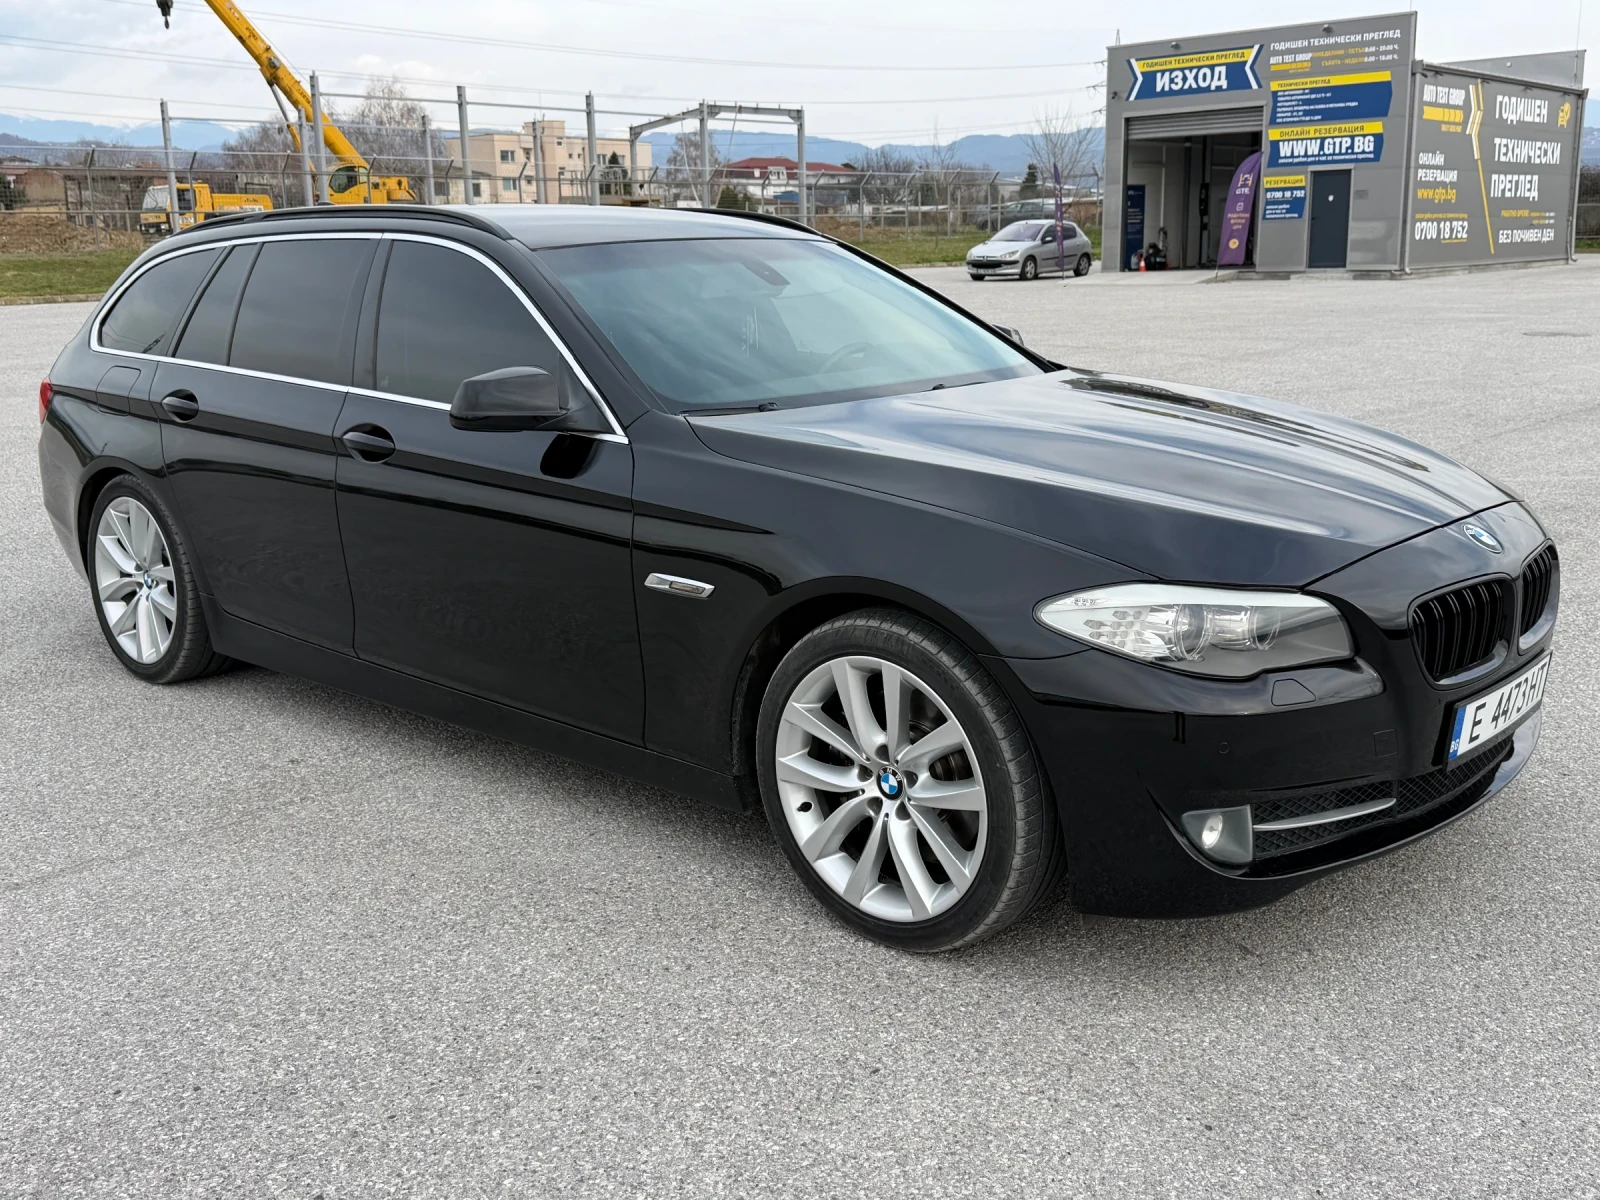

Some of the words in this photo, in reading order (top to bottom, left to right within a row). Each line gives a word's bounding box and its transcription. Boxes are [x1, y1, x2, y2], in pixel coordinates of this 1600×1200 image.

[1270, 40, 1308, 50] ГОДИШЕН
[1310, 34, 1361, 46] ТЕХНИЧЕСКИ
[1363, 29, 1400, 40] ПРЕГЛЕД
[1142, 60, 1172, 69] ГОДИШЕН
[1174, 56, 1214, 66] ТЕХНИЧЕСКИ
[1216, 52, 1245, 60] ПРЕГЛЕД
[1270, 56, 1282, 64] AUTO
[1283, 54, 1294, 63] TEST
[1156, 66, 1228, 92] ИЗХОД
[1278, 80, 1308, 88] ТЕХНИЧЕСКИ
[1309, 78, 1330, 86] ПРЕГЛЕД
[1423, 84, 1436, 102] AUTO
[1437, 86, 1448, 104] TEST
[1449, 88, 1466, 106] GROUP
[1496, 94, 1548, 125] ГОДИШЕН
[1280, 130, 1310, 138] ОНЛАЙН
[1314, 125, 1364, 135] РЕЗЕРВАЦИЯ
[1418, 151, 1444, 166] ОНЛАЙН
[1494, 138, 1561, 164] ТЕХНИЧЕСКИ
[1266, 178, 1304, 186] РЕЗЕРВАЦИЯ
[1418, 168, 1458, 184] РЕЗЕРВАЦИЯ
[1292, 190, 1305, 198] 752
[1417, 184, 1456, 204] www.gtp.bg
[1490, 174, 1538, 201] ПРЕГЛЕД
[1415, 221, 1438, 240] 0700
[1440, 221, 1450, 239] 18
[1452, 220, 1468, 239] 752
[1498, 230, 1512, 244] БЕЗ
[1512, 229, 1541, 242] ПОЧИВЕН
[1542, 228, 1554, 243] ДЕН
[1468, 702, 1487, 744] E
[879, 768, 902, 781] BMW
